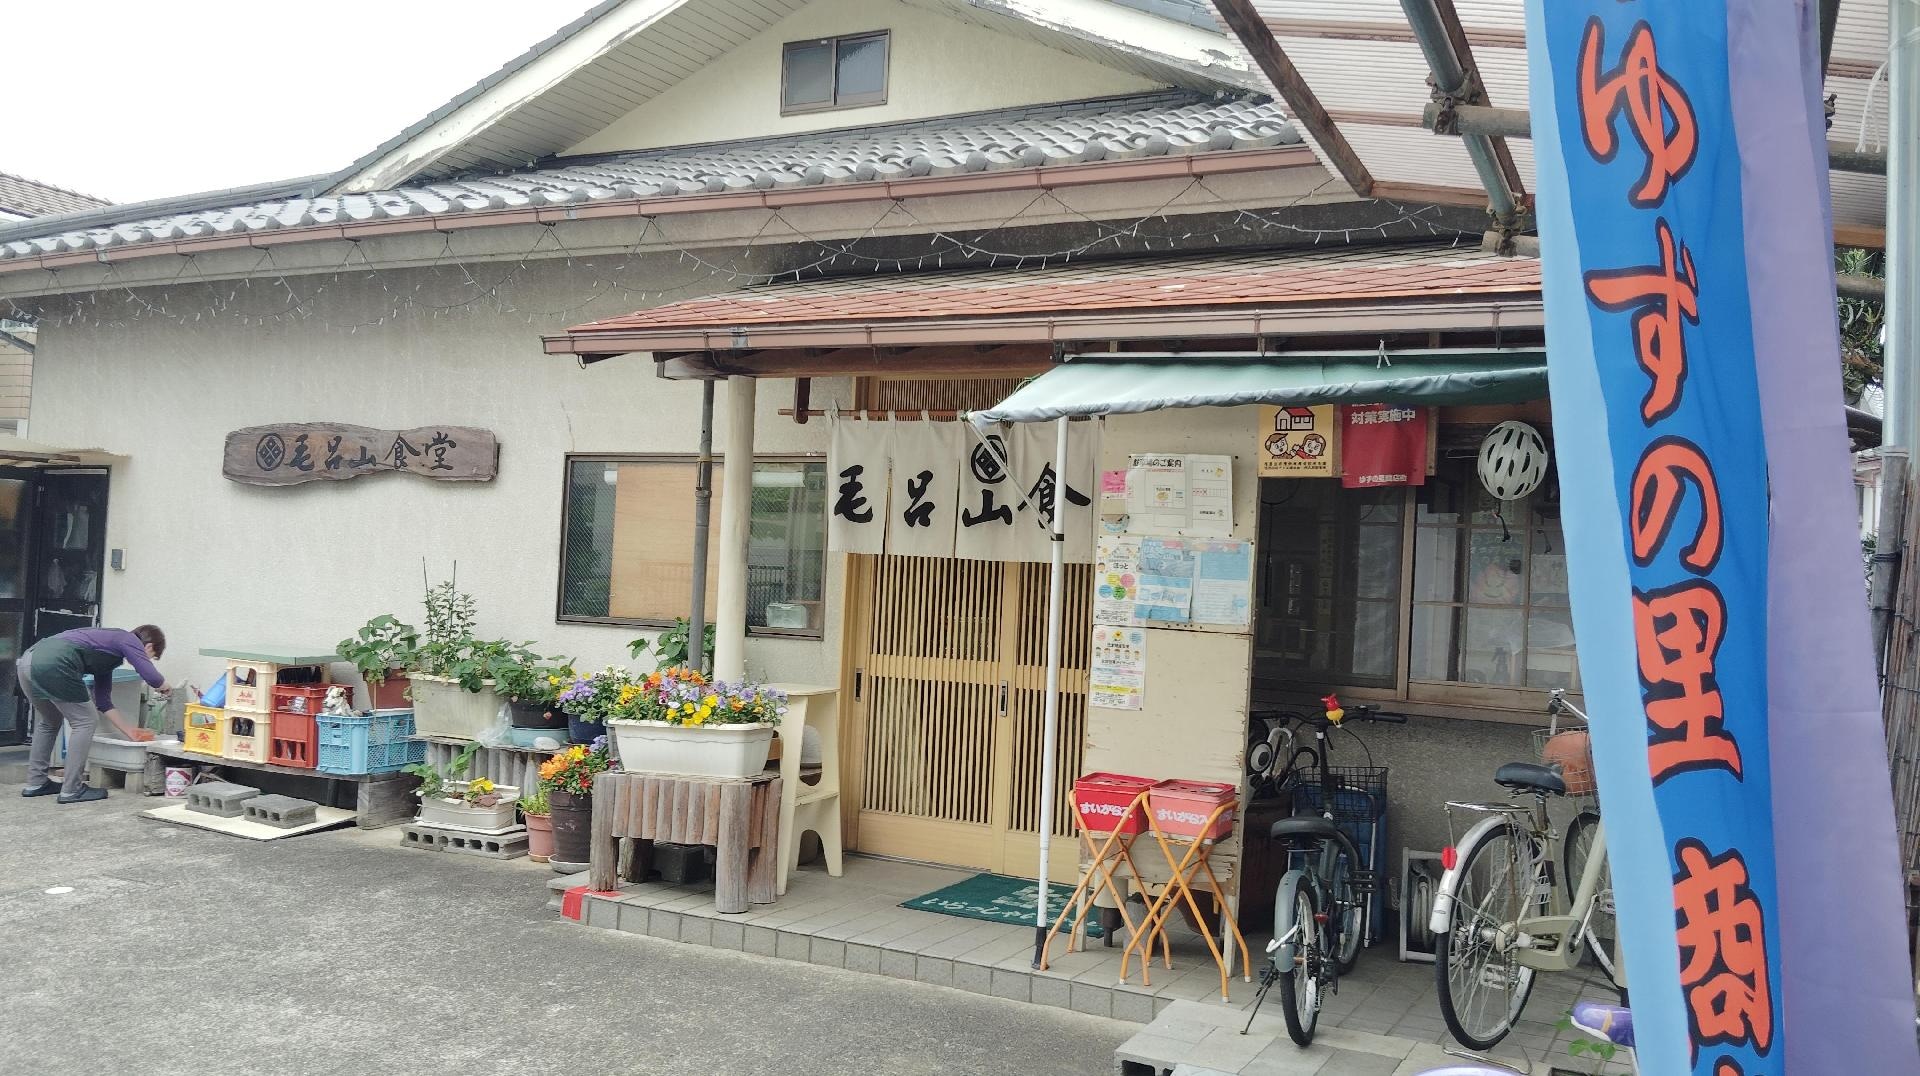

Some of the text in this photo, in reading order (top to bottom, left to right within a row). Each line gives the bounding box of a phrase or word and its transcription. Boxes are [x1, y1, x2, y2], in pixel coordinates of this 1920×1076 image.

[1351, 408, 1416, 425] 対策実施中
[284, 431, 457, 471] 毛呂山食堂
